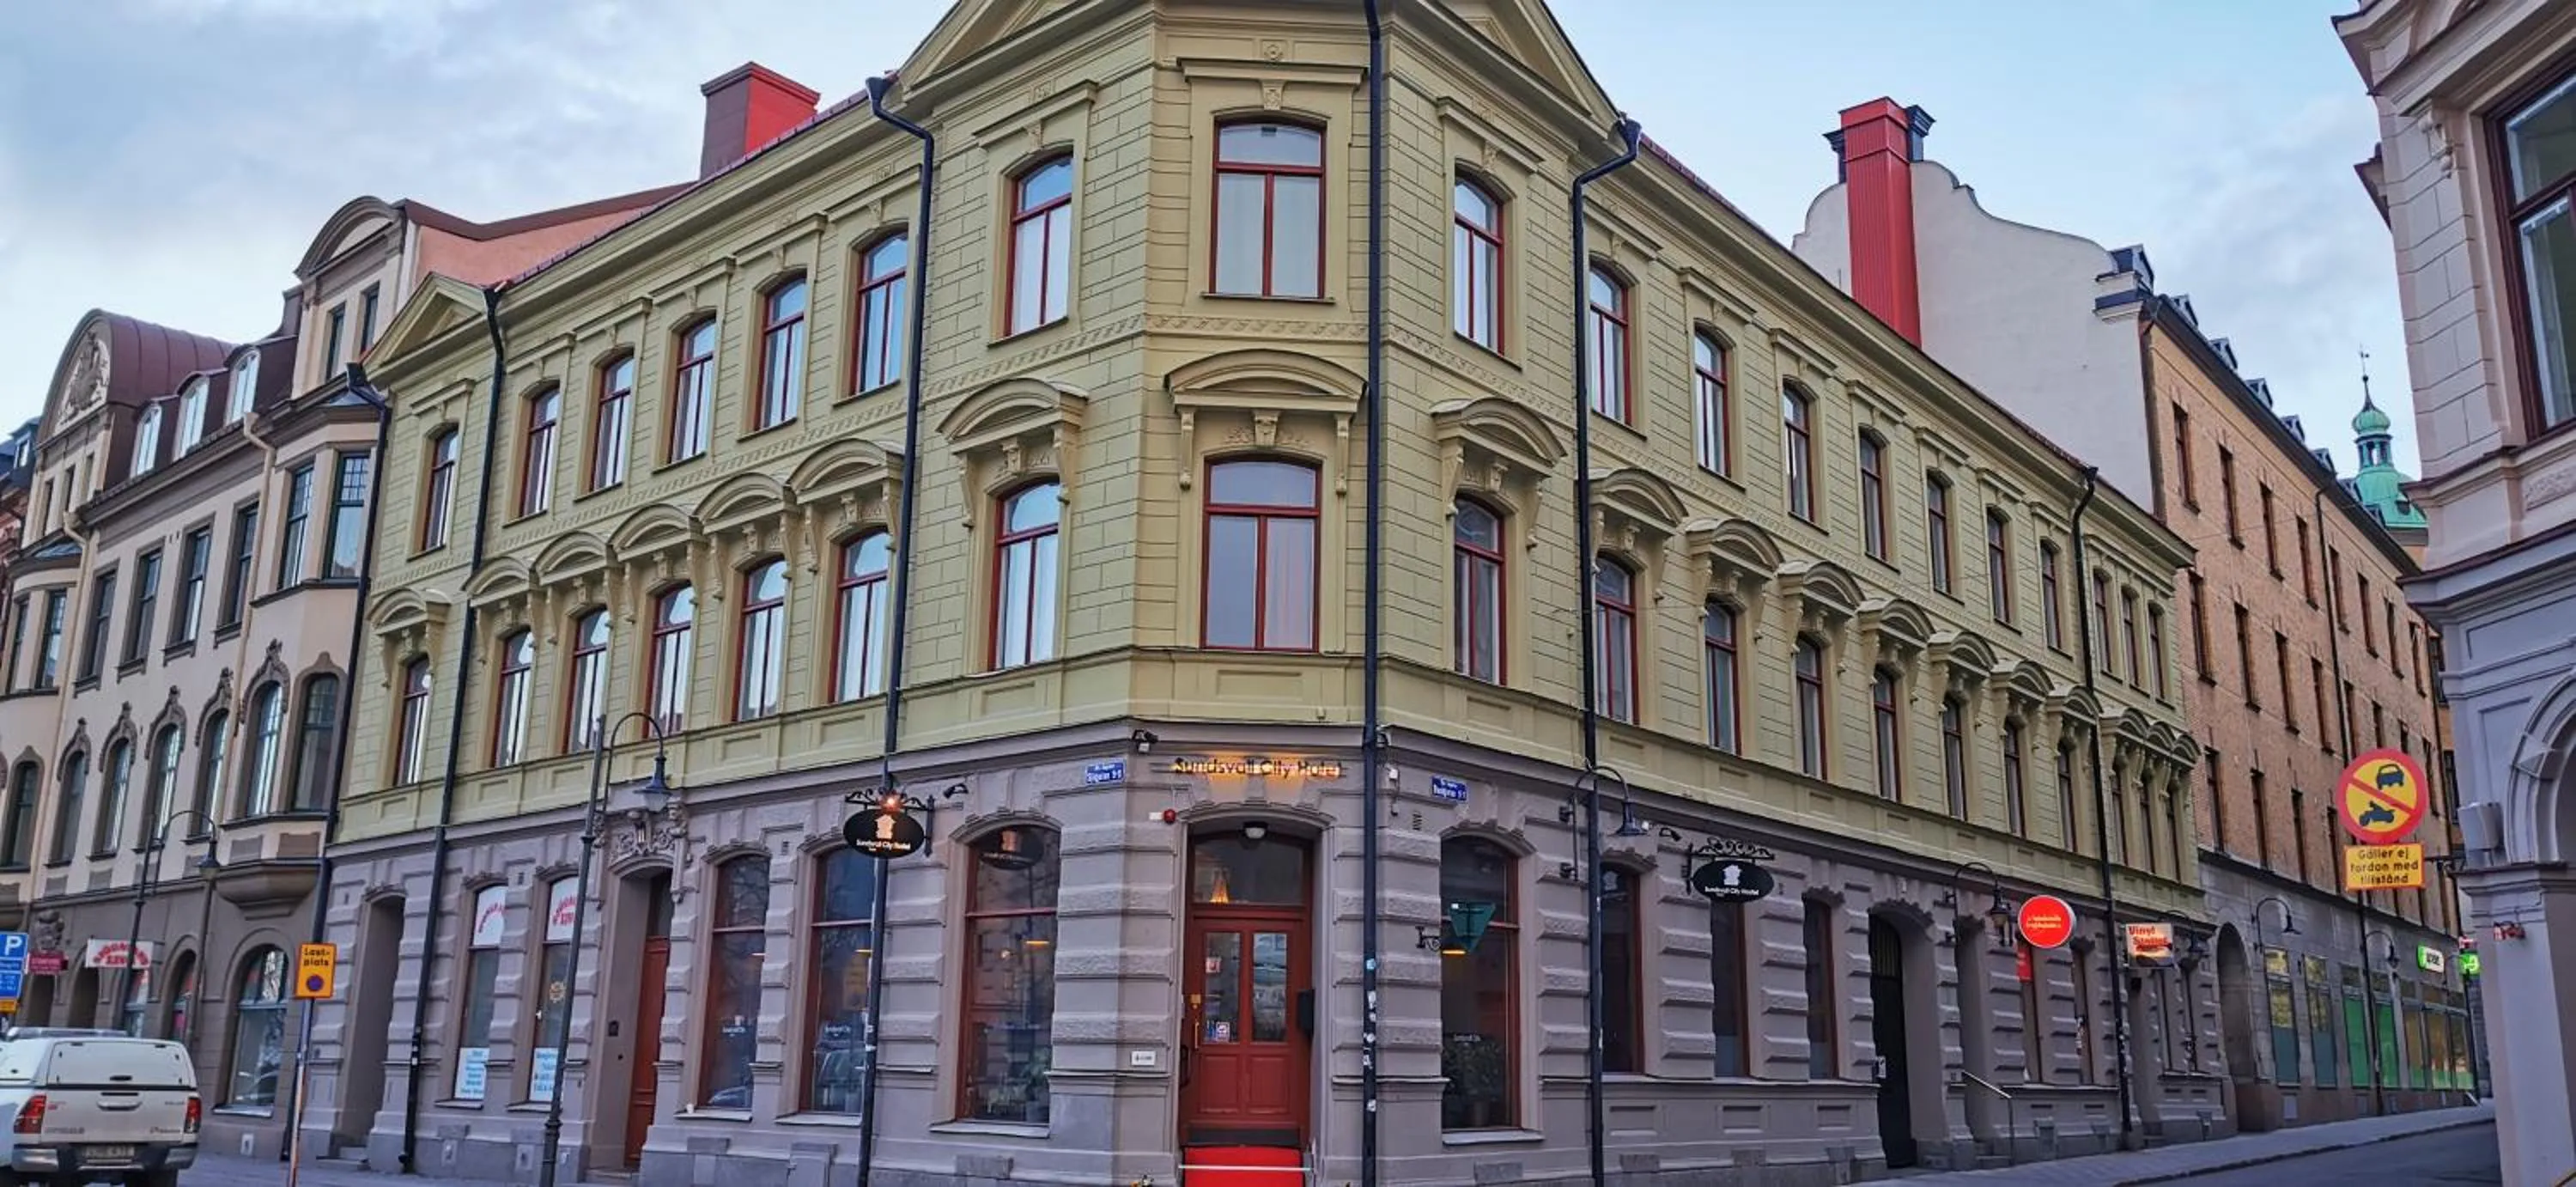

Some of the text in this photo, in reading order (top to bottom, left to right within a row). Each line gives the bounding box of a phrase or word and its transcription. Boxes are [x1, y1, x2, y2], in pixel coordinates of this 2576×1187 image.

[1175, 757, 1255, 774] Sundsvall
[1260, 759, 1292, 779] City
[2397, 847, 2409, 860] ej
[2350, 859, 2419, 873] fordon med
[4, 935, 23, 956] P
